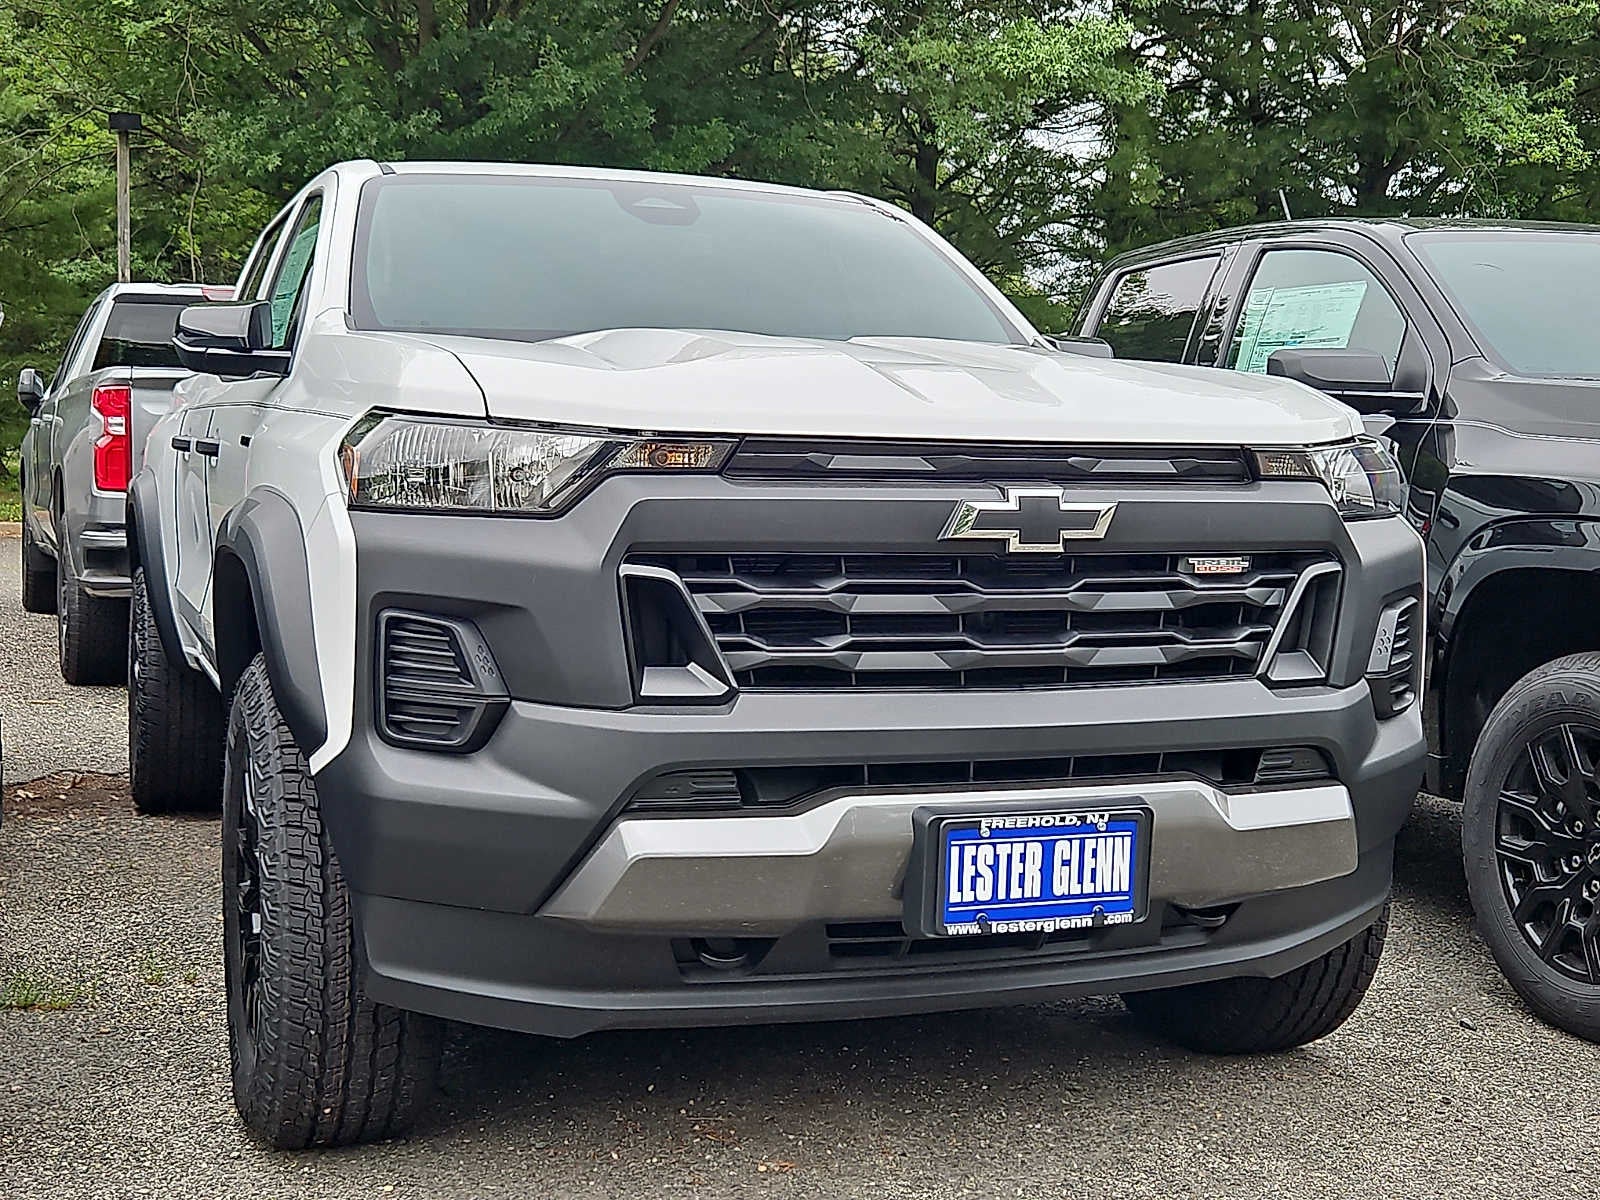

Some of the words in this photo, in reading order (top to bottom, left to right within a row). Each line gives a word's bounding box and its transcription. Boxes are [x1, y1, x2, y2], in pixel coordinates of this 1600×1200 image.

[980, 814, 1081, 830] FREEHOLD,
[1086, 813, 1110, 827] NJ
[949, 841, 1042, 903] LESTER
[1052, 837, 1132, 896] GLENN
